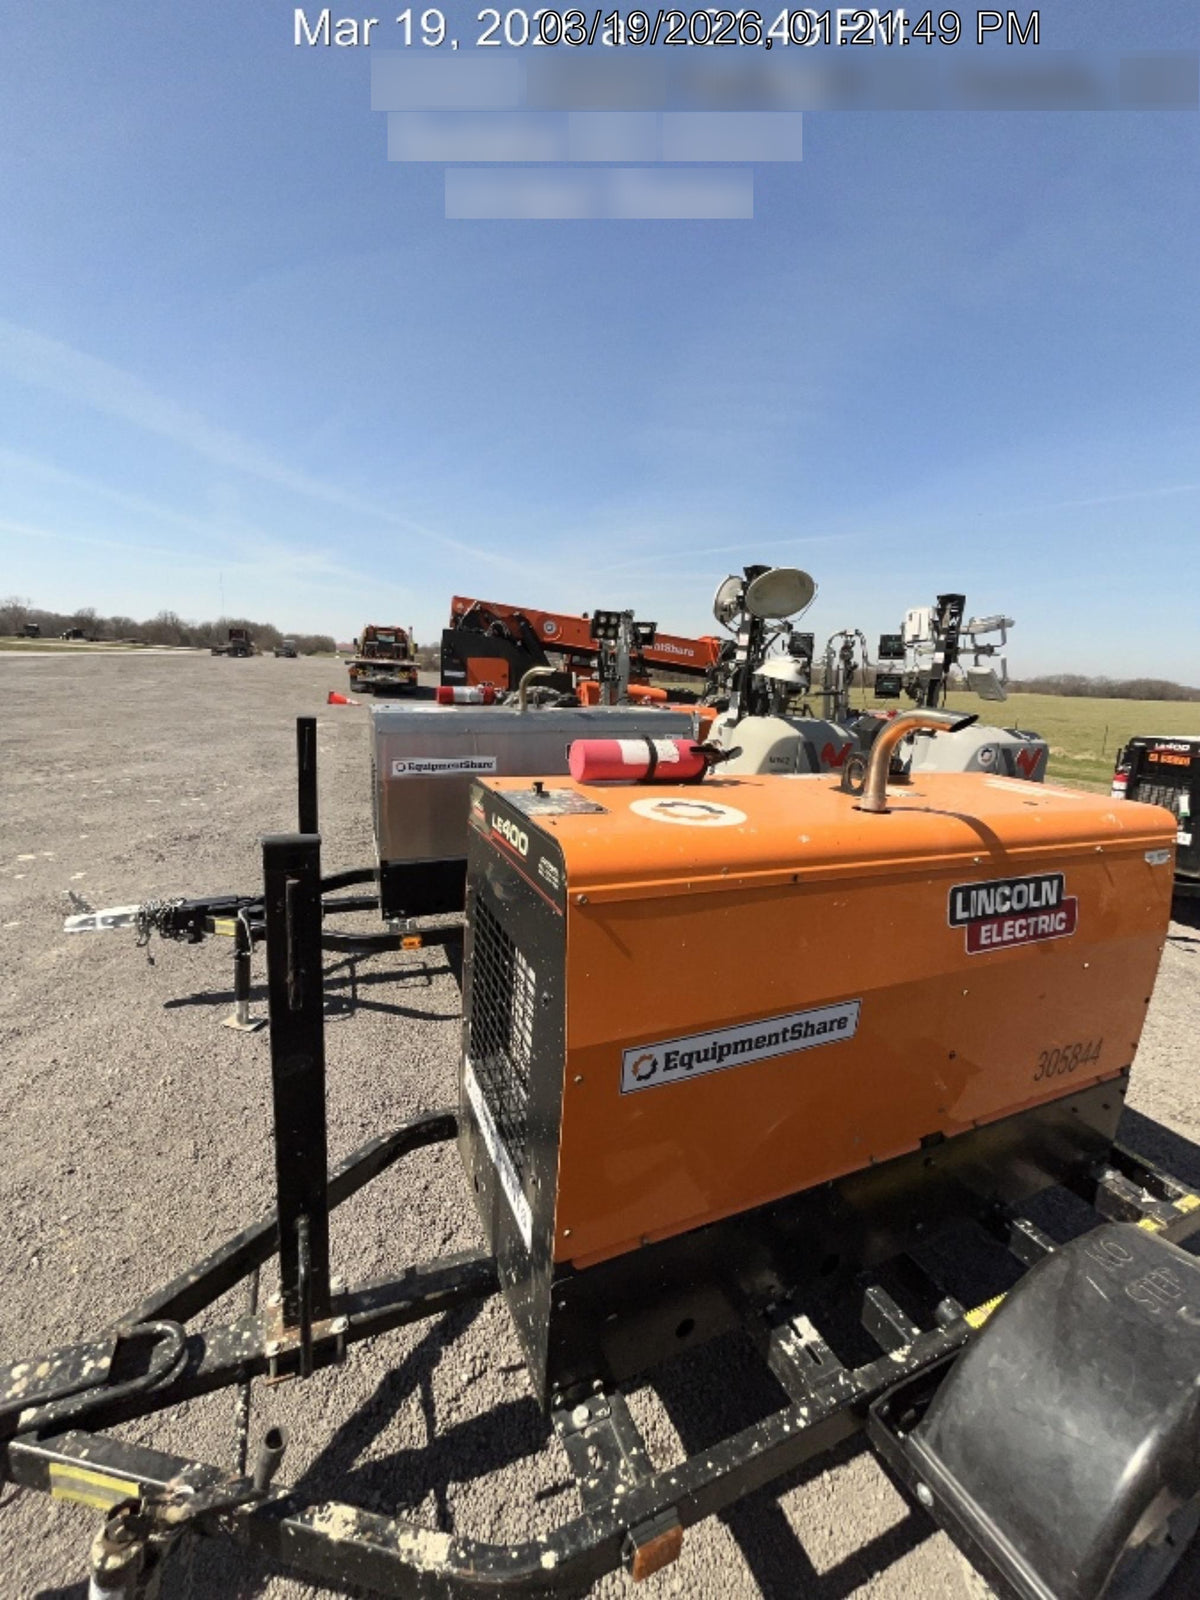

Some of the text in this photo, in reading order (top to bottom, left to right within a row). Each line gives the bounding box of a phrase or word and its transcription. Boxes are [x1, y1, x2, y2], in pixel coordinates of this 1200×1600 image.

[956, 879, 1059, 920] LINCOLN
[980, 911, 1067, 945] ELECTRIC
[662, 1014, 849, 1073] EquipmentShare
[1033, 1037, 1104, 1082] 305844
